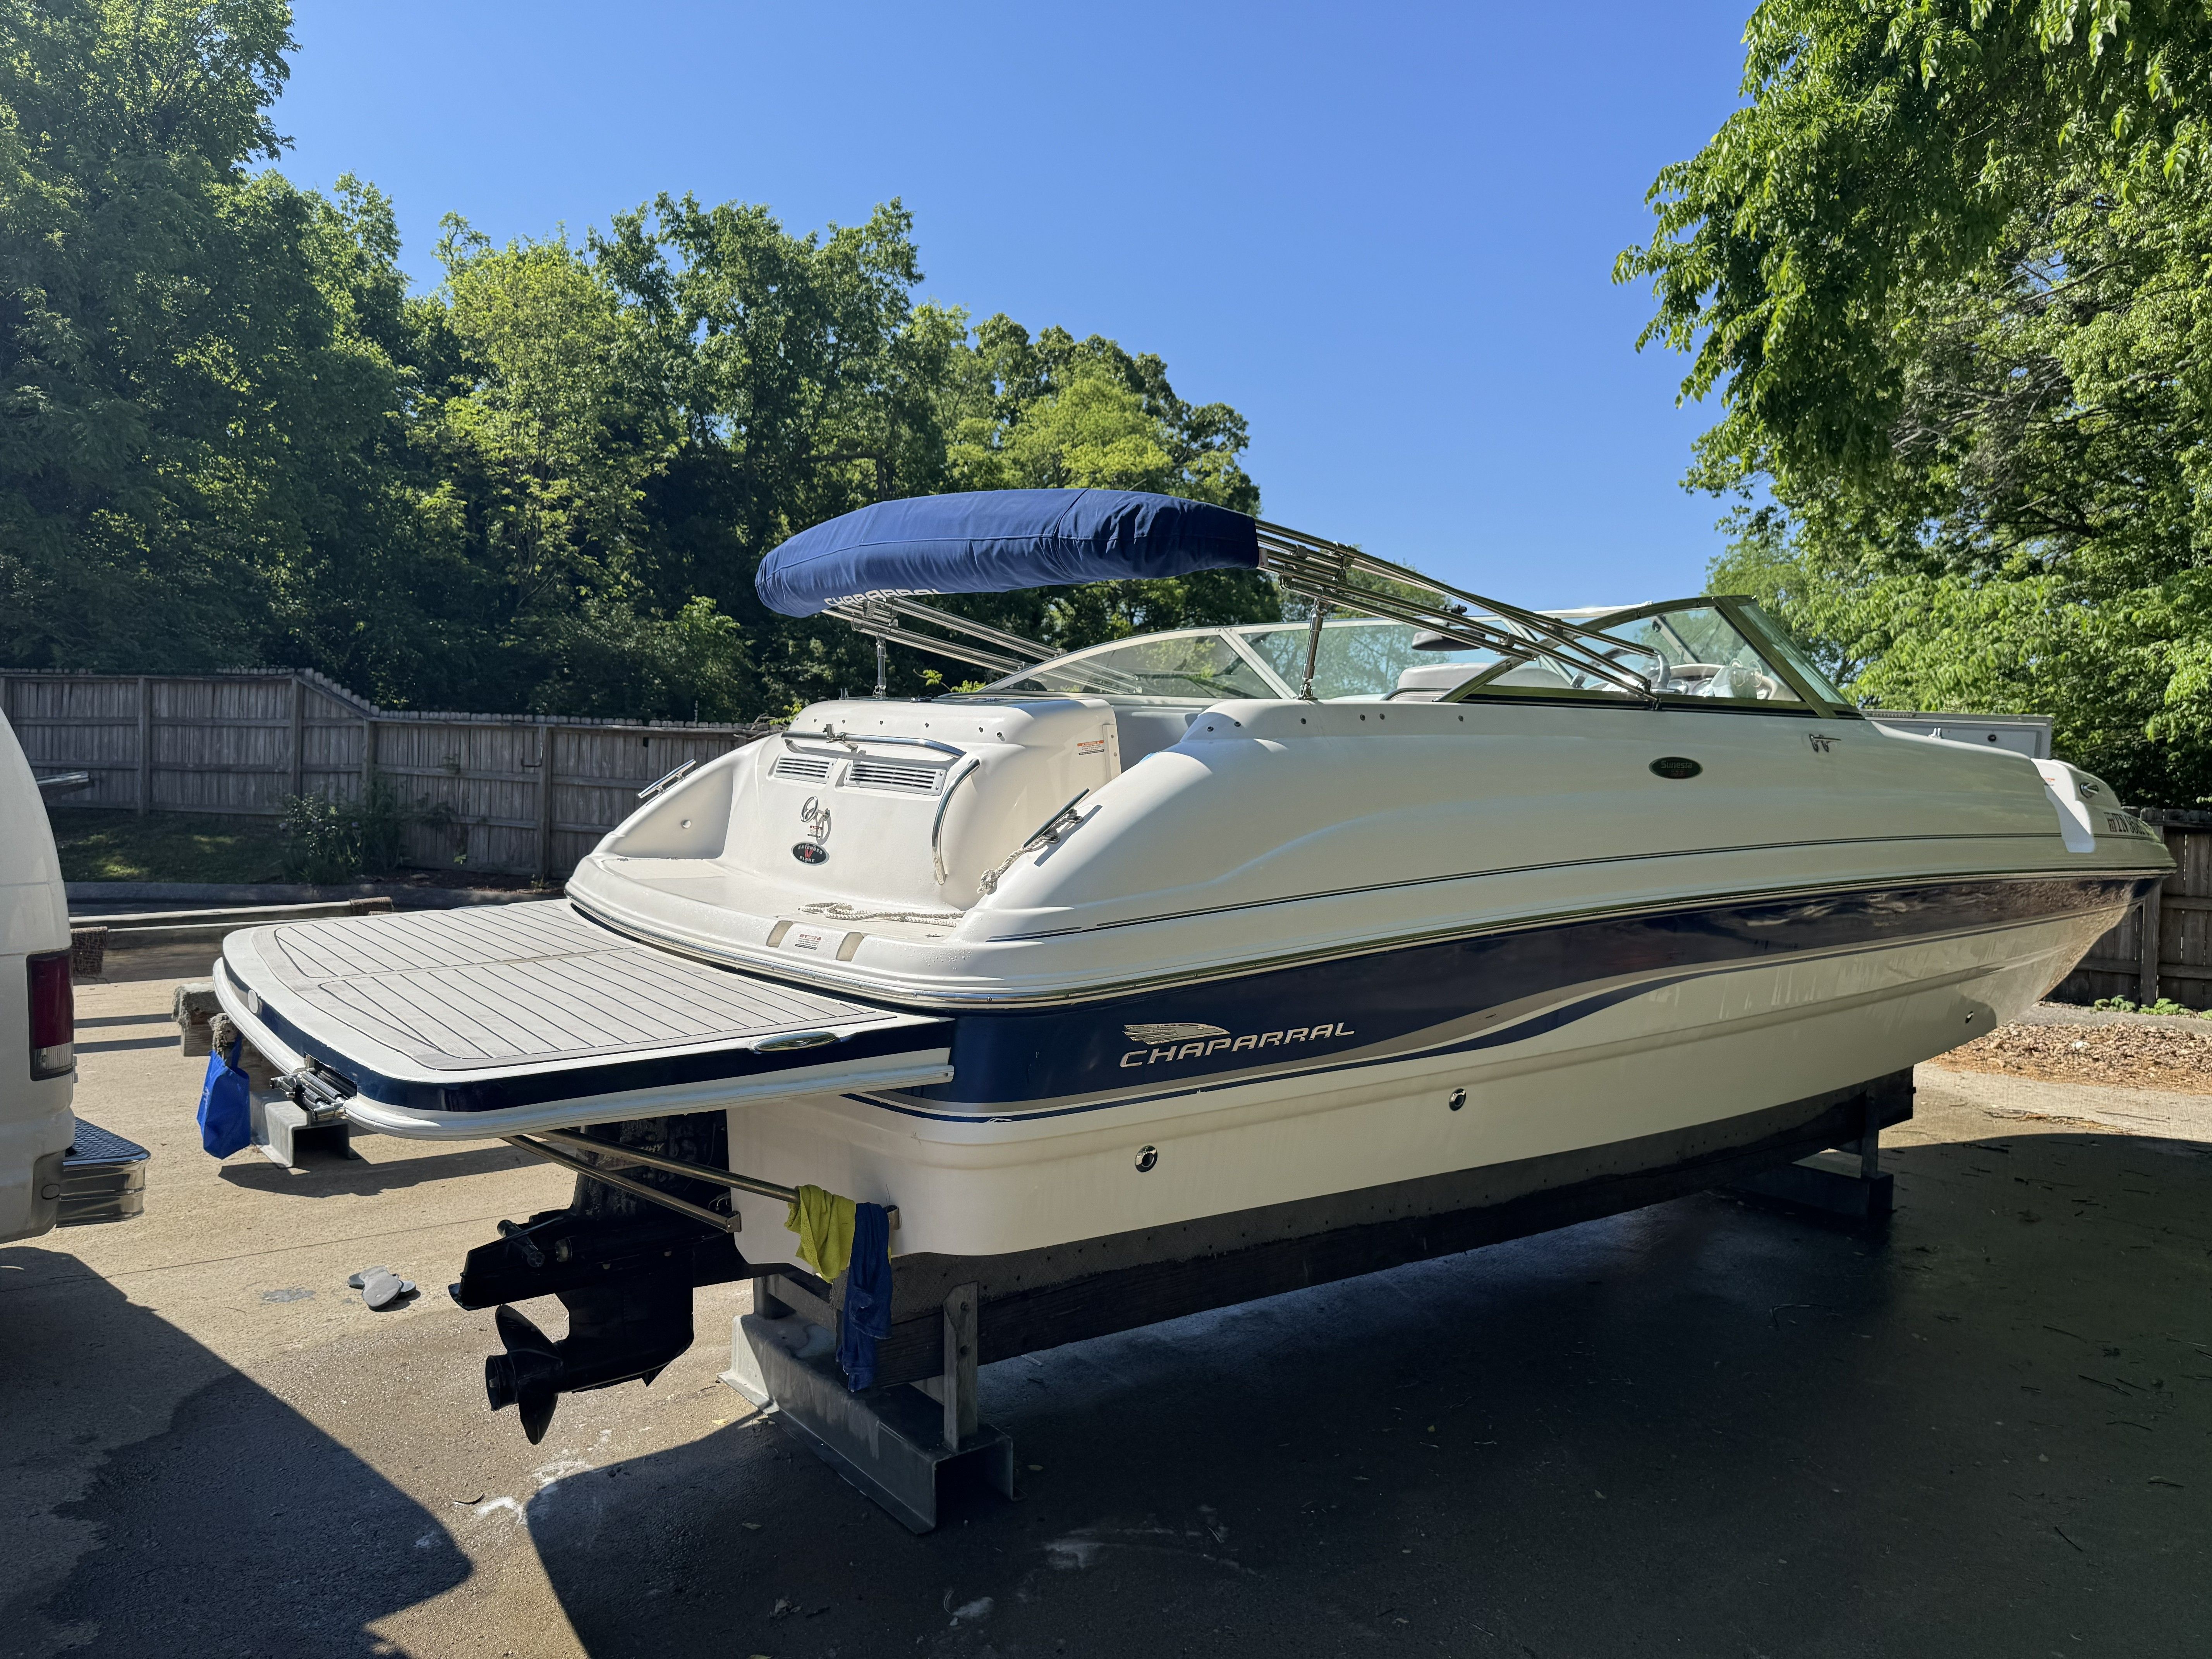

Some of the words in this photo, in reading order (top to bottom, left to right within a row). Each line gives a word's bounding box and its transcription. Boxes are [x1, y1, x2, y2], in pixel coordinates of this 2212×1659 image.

[1661, 760, 1692, 769] Sunesta
[798, 845, 823, 854] EXTENDED
[1120, 1022, 1355, 1067] CHAPARRAL
